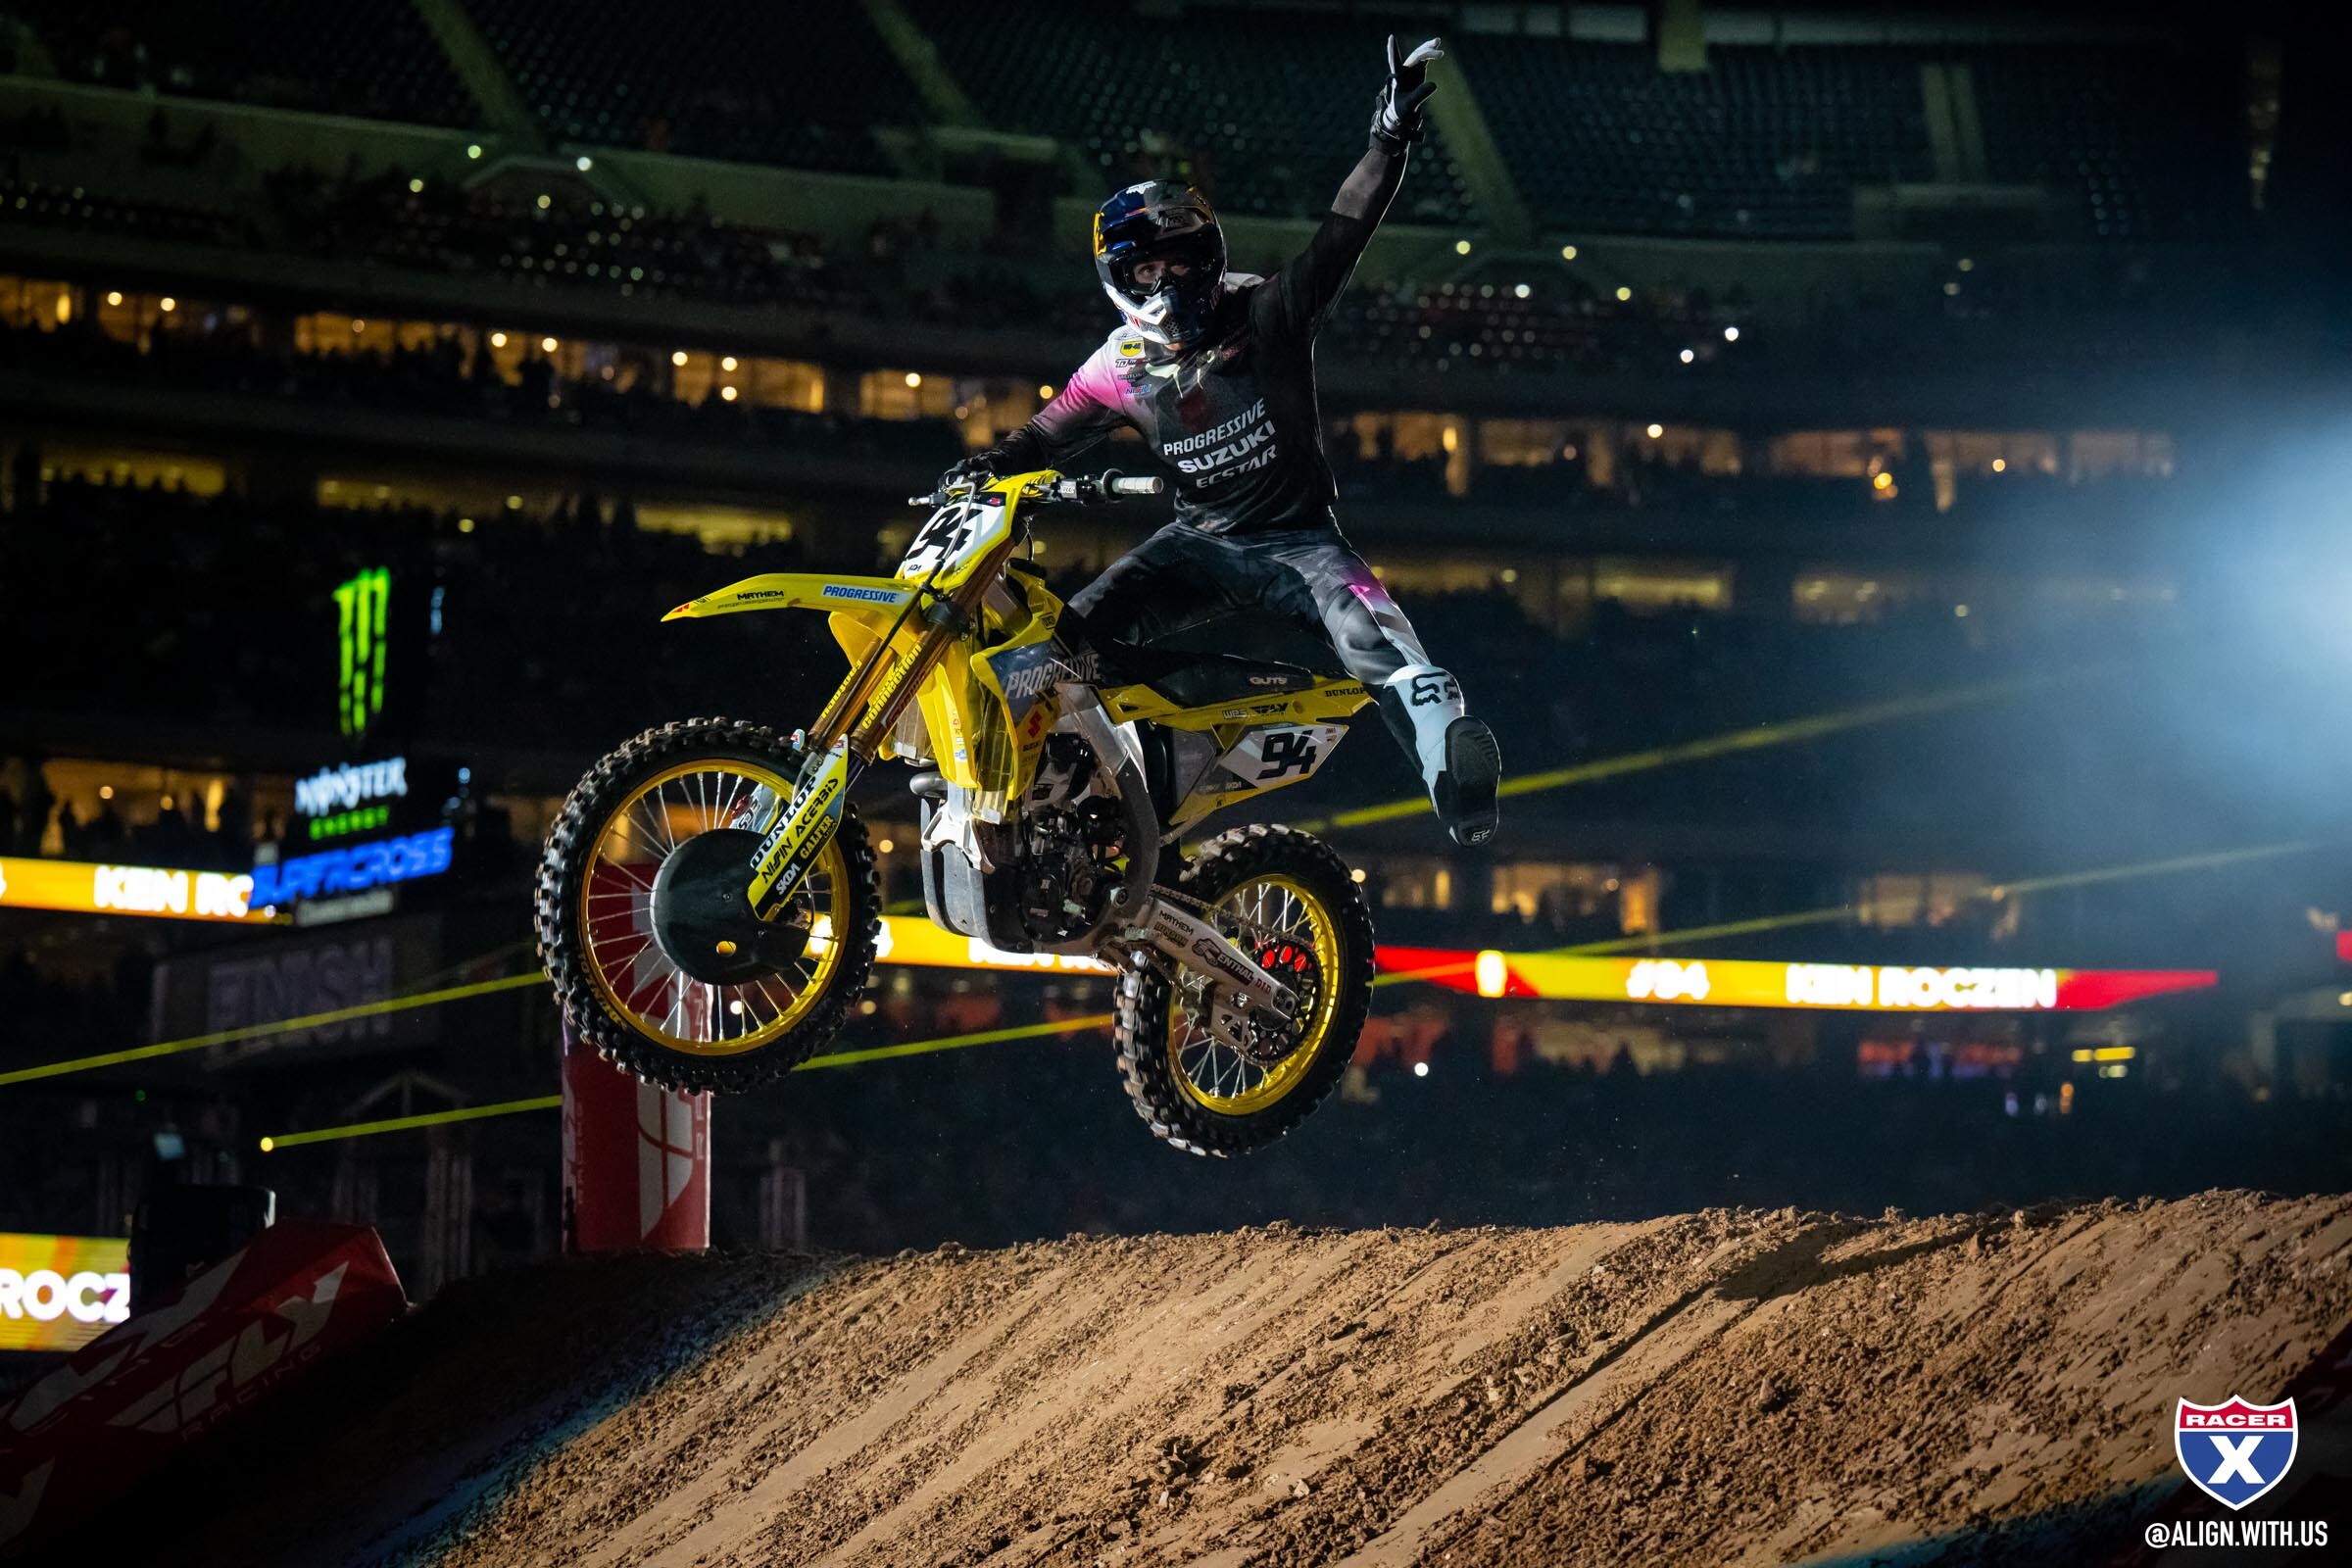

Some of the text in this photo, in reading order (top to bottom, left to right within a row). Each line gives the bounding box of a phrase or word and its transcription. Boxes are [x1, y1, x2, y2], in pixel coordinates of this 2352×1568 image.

[1163, 397, 1266, 456] PROGRESSIVE
[1177, 419, 1276, 474] SUZUKI
[1196, 444, 1277, 489] ECSTAR
[736, 590, 784, 600] MAYHEM
[822, 585, 898, 603] PROGRESSIVE
[1256, 730, 1317, 780] 94
[750, 776, 816, 869] DUNLOP
[800, 814, 834, 859] GALFER
[94, 864, 189, 913] KEN
[1158, 909, 1195, 936] MAYHEM
[1786, 963, 1873, 1005] KEN
[1879, 967, 2057, 1008] ROCZEN
[104, 1259, 351, 1435] FLY
